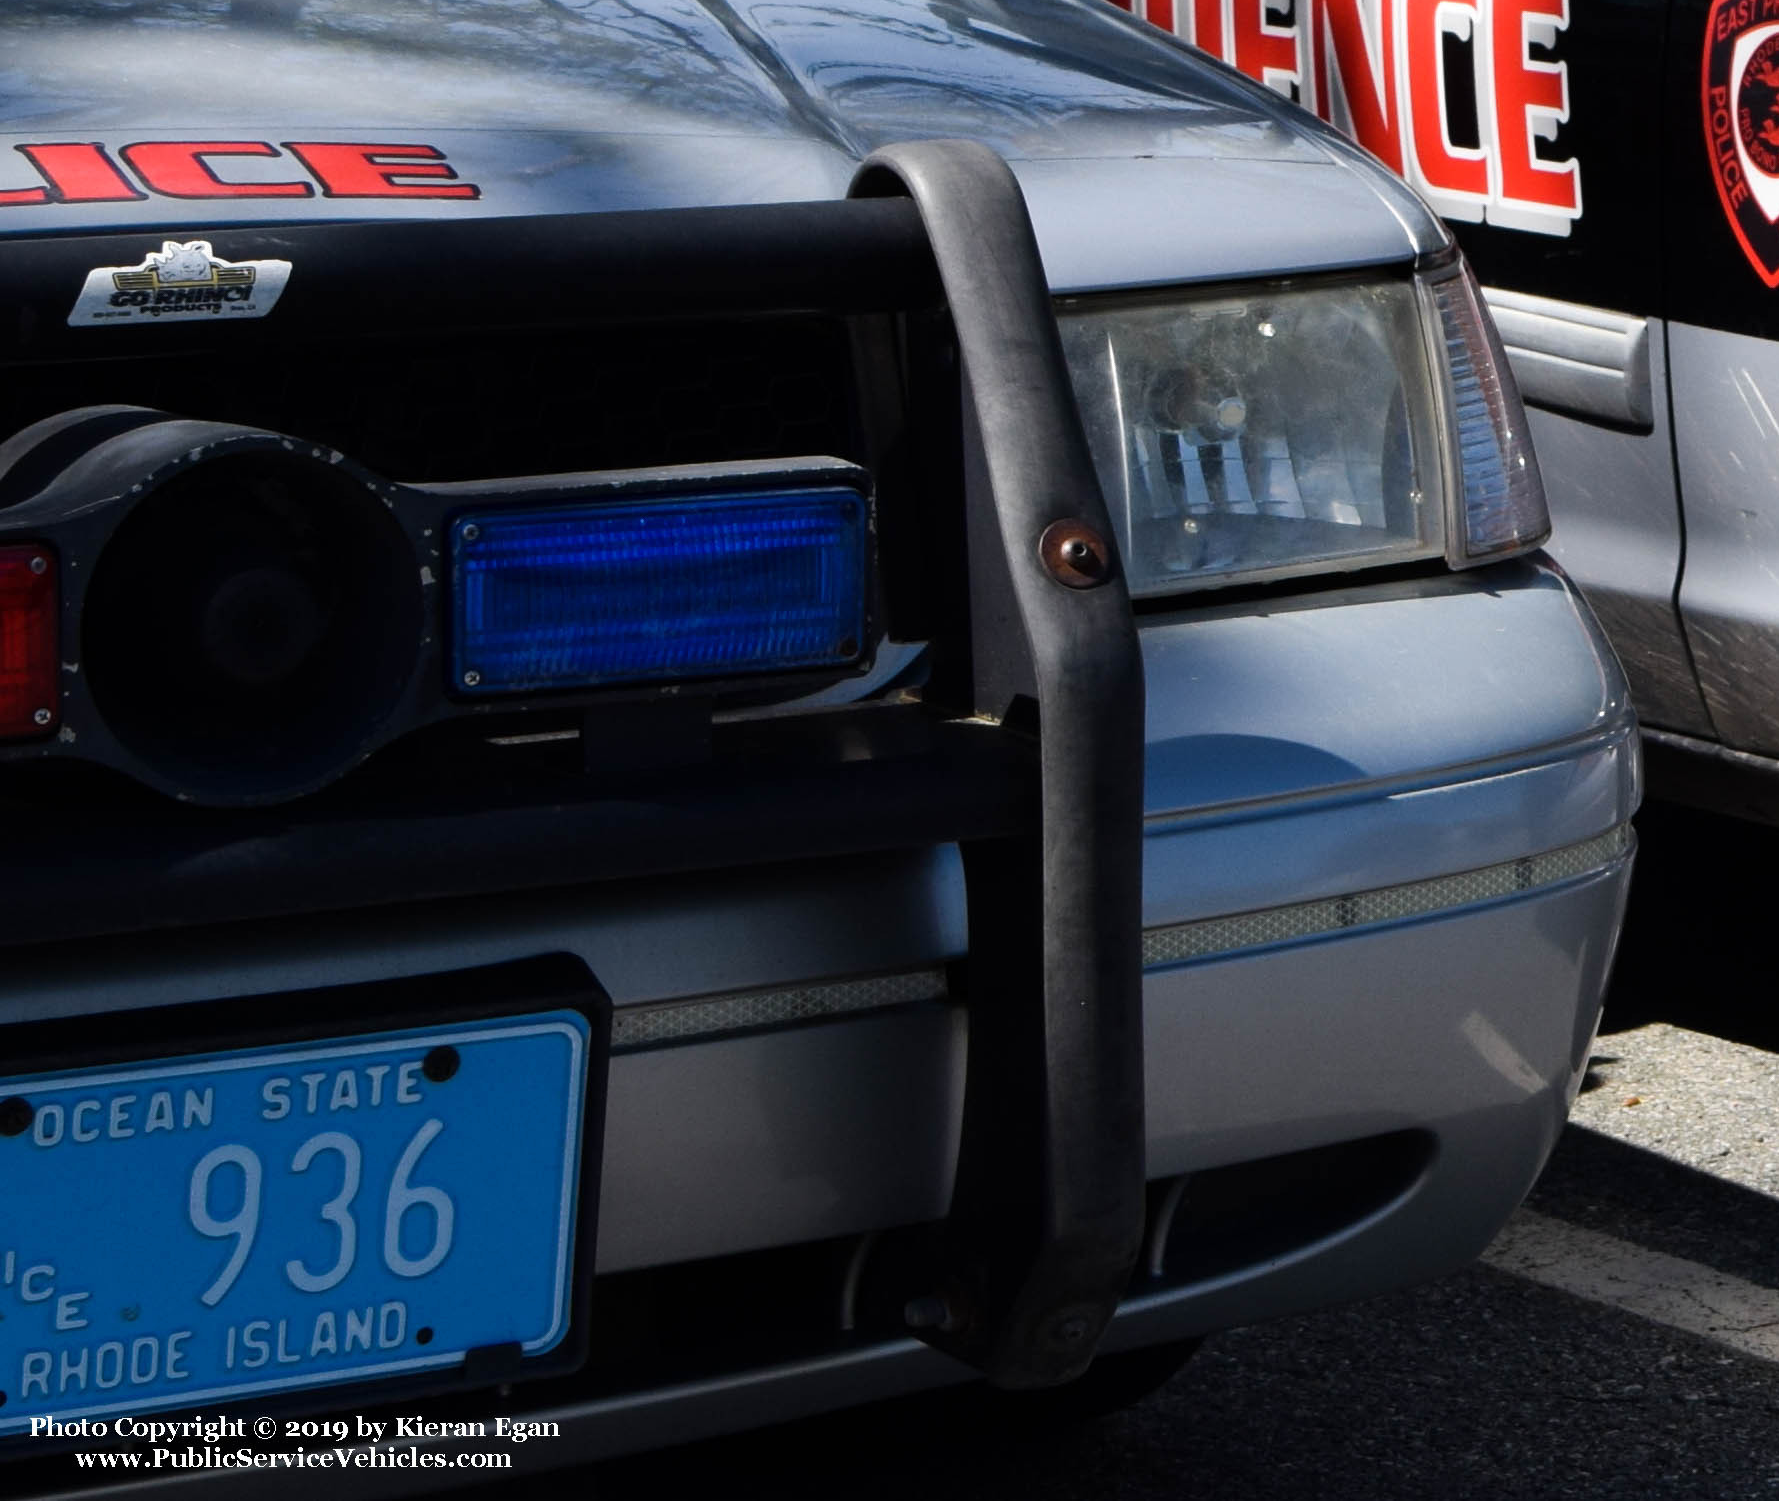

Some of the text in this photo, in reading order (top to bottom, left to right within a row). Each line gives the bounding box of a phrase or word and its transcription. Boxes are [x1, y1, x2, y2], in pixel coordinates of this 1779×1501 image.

[0, 141, 482, 207] ICE
[1710, 86, 1749, 211] POLICE
[33, 1060, 424, 1147] OCEAN STATE
[188, 1118, 454, 1306] 936
[22, 1301, 407, 1397] RHODE ISLAND
